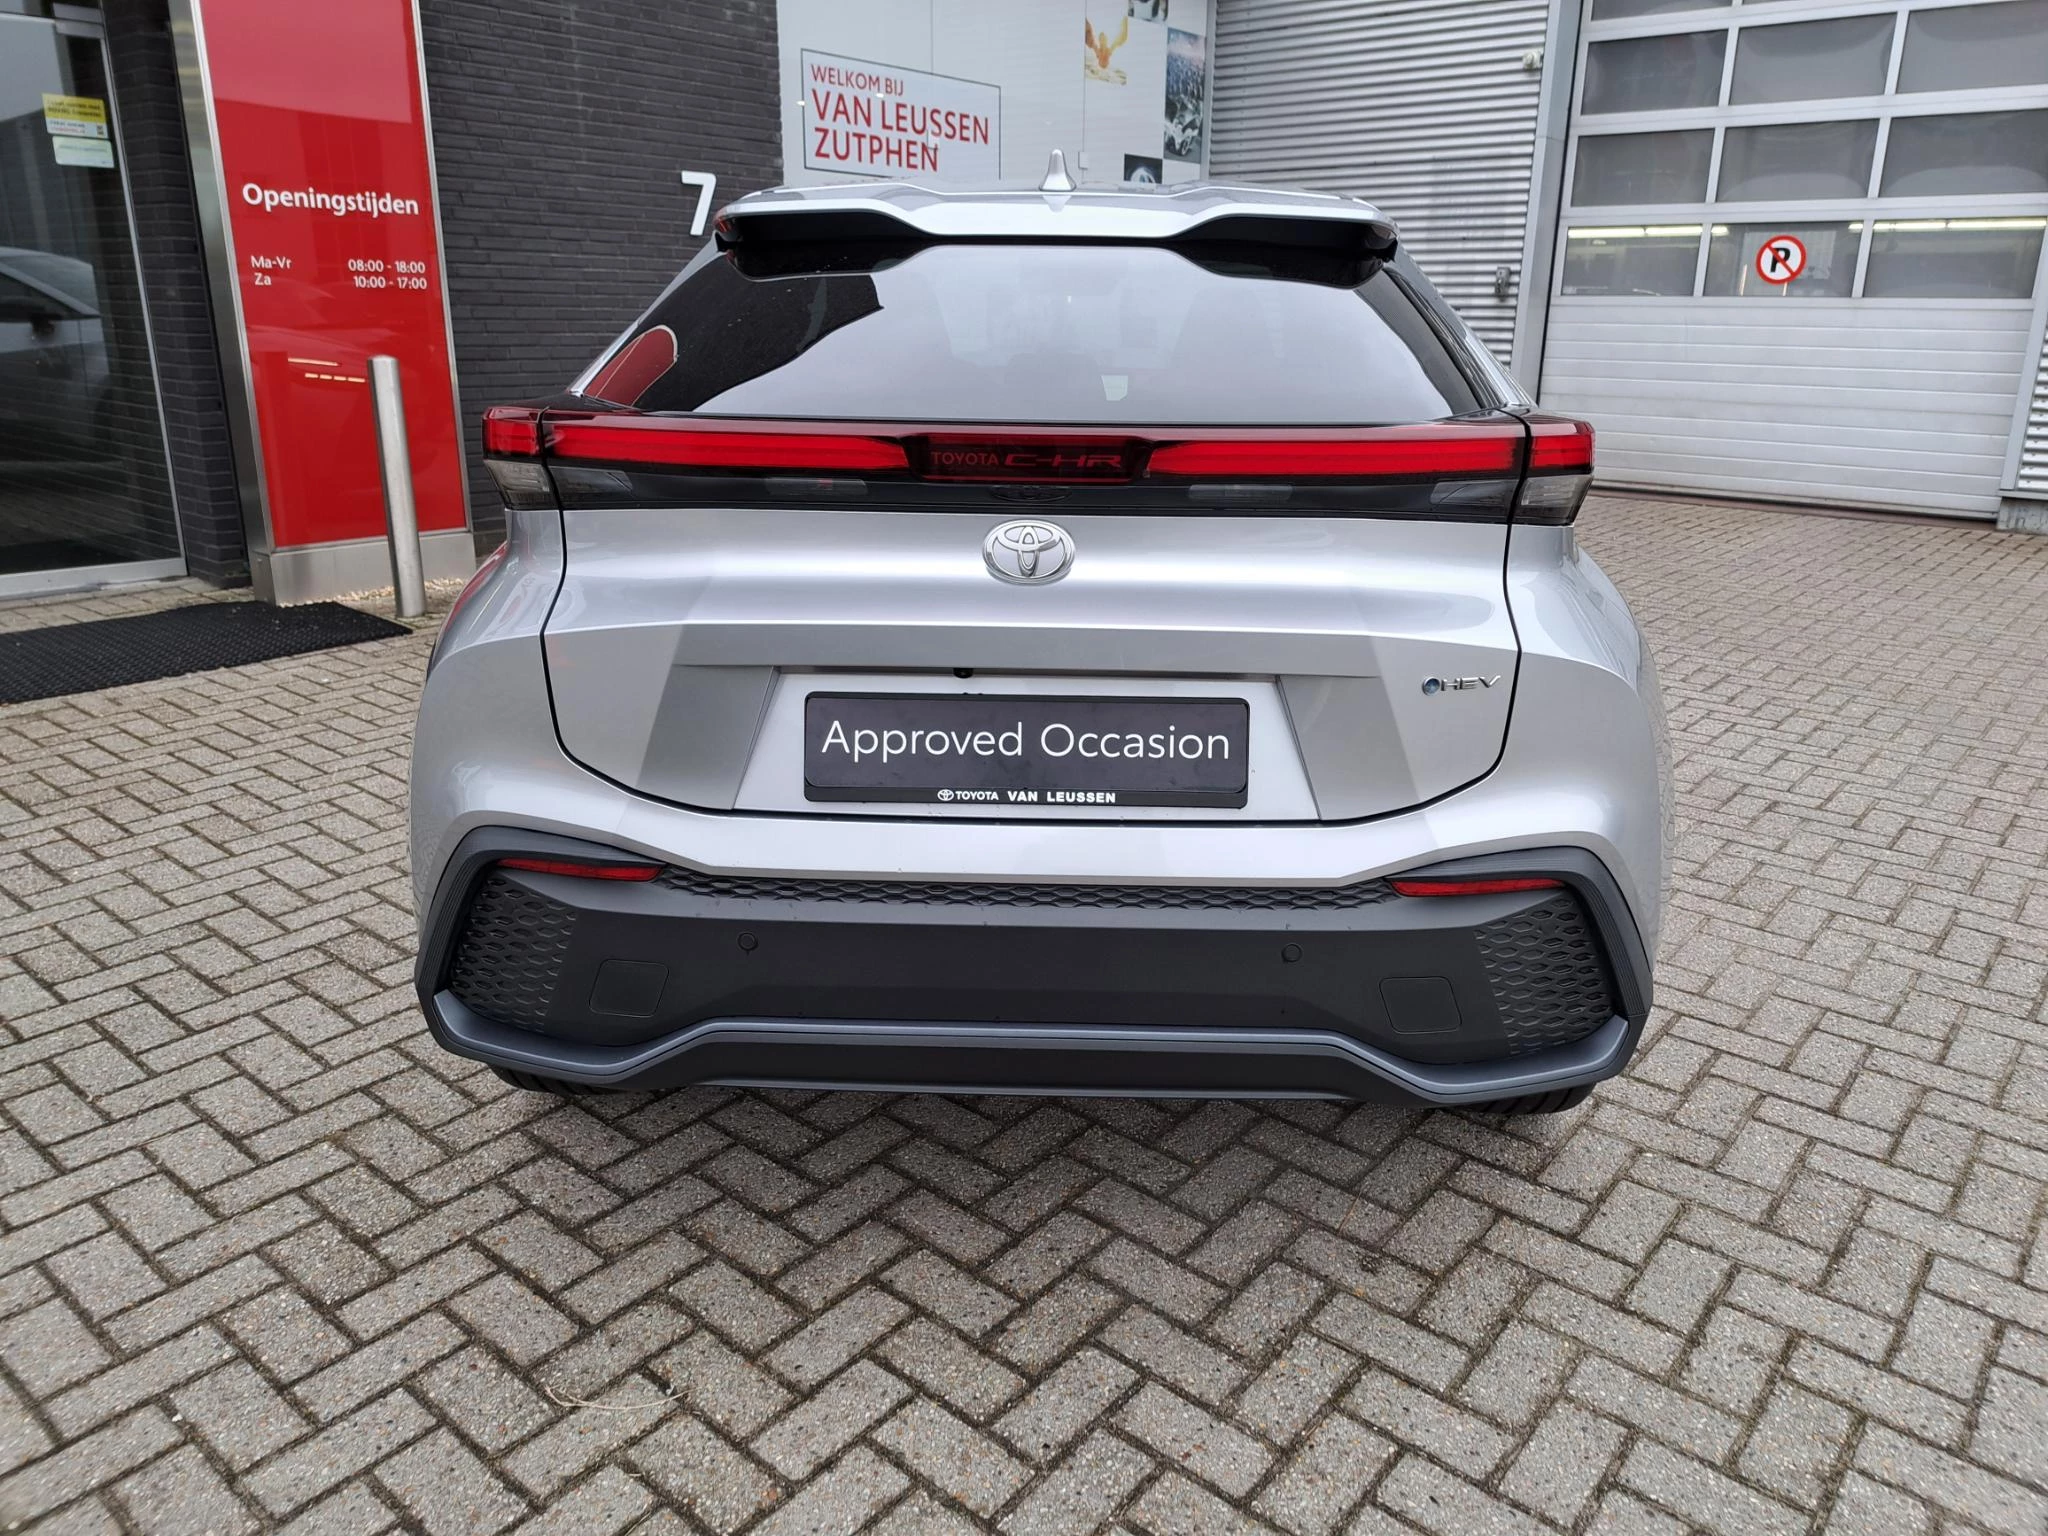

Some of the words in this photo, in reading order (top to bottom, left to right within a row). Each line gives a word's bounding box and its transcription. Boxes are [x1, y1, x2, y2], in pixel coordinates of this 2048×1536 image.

[811, 63, 881, 92] WELKOM
[884, 78, 904, 96] BIJ
[812, 88, 872, 128] VAN
[881, 100, 989, 145] LEUSSEN
[814, 127, 939, 172] ZUTPHEN
[242, 183, 419, 218] Openingstijden
[681, 170, 717, 236] 7
[250, 255, 292, 269] Ma-Vr
[348, 259, 384, 272] 08:00
[395, 260, 426, 273] 18:00
[1770, 247, 1791, 273] P
[254, 273, 272, 285] Za
[353, 275, 386, 288] 10:00
[396, 277, 427, 289] 17:00
[930, 451, 999, 465] TOYOTA
[1004, 454, 1121, 468] C-HR
[1440, 675, 1501, 691] HEV
[821, 719, 1023, 762] Approved
[1040, 722, 1229, 760] Occasion
[955, 790, 999, 801] TOYOTA
[1007, 790, 1038, 802] VAN
[1047, 791, 1116, 803] LEUSSEN
